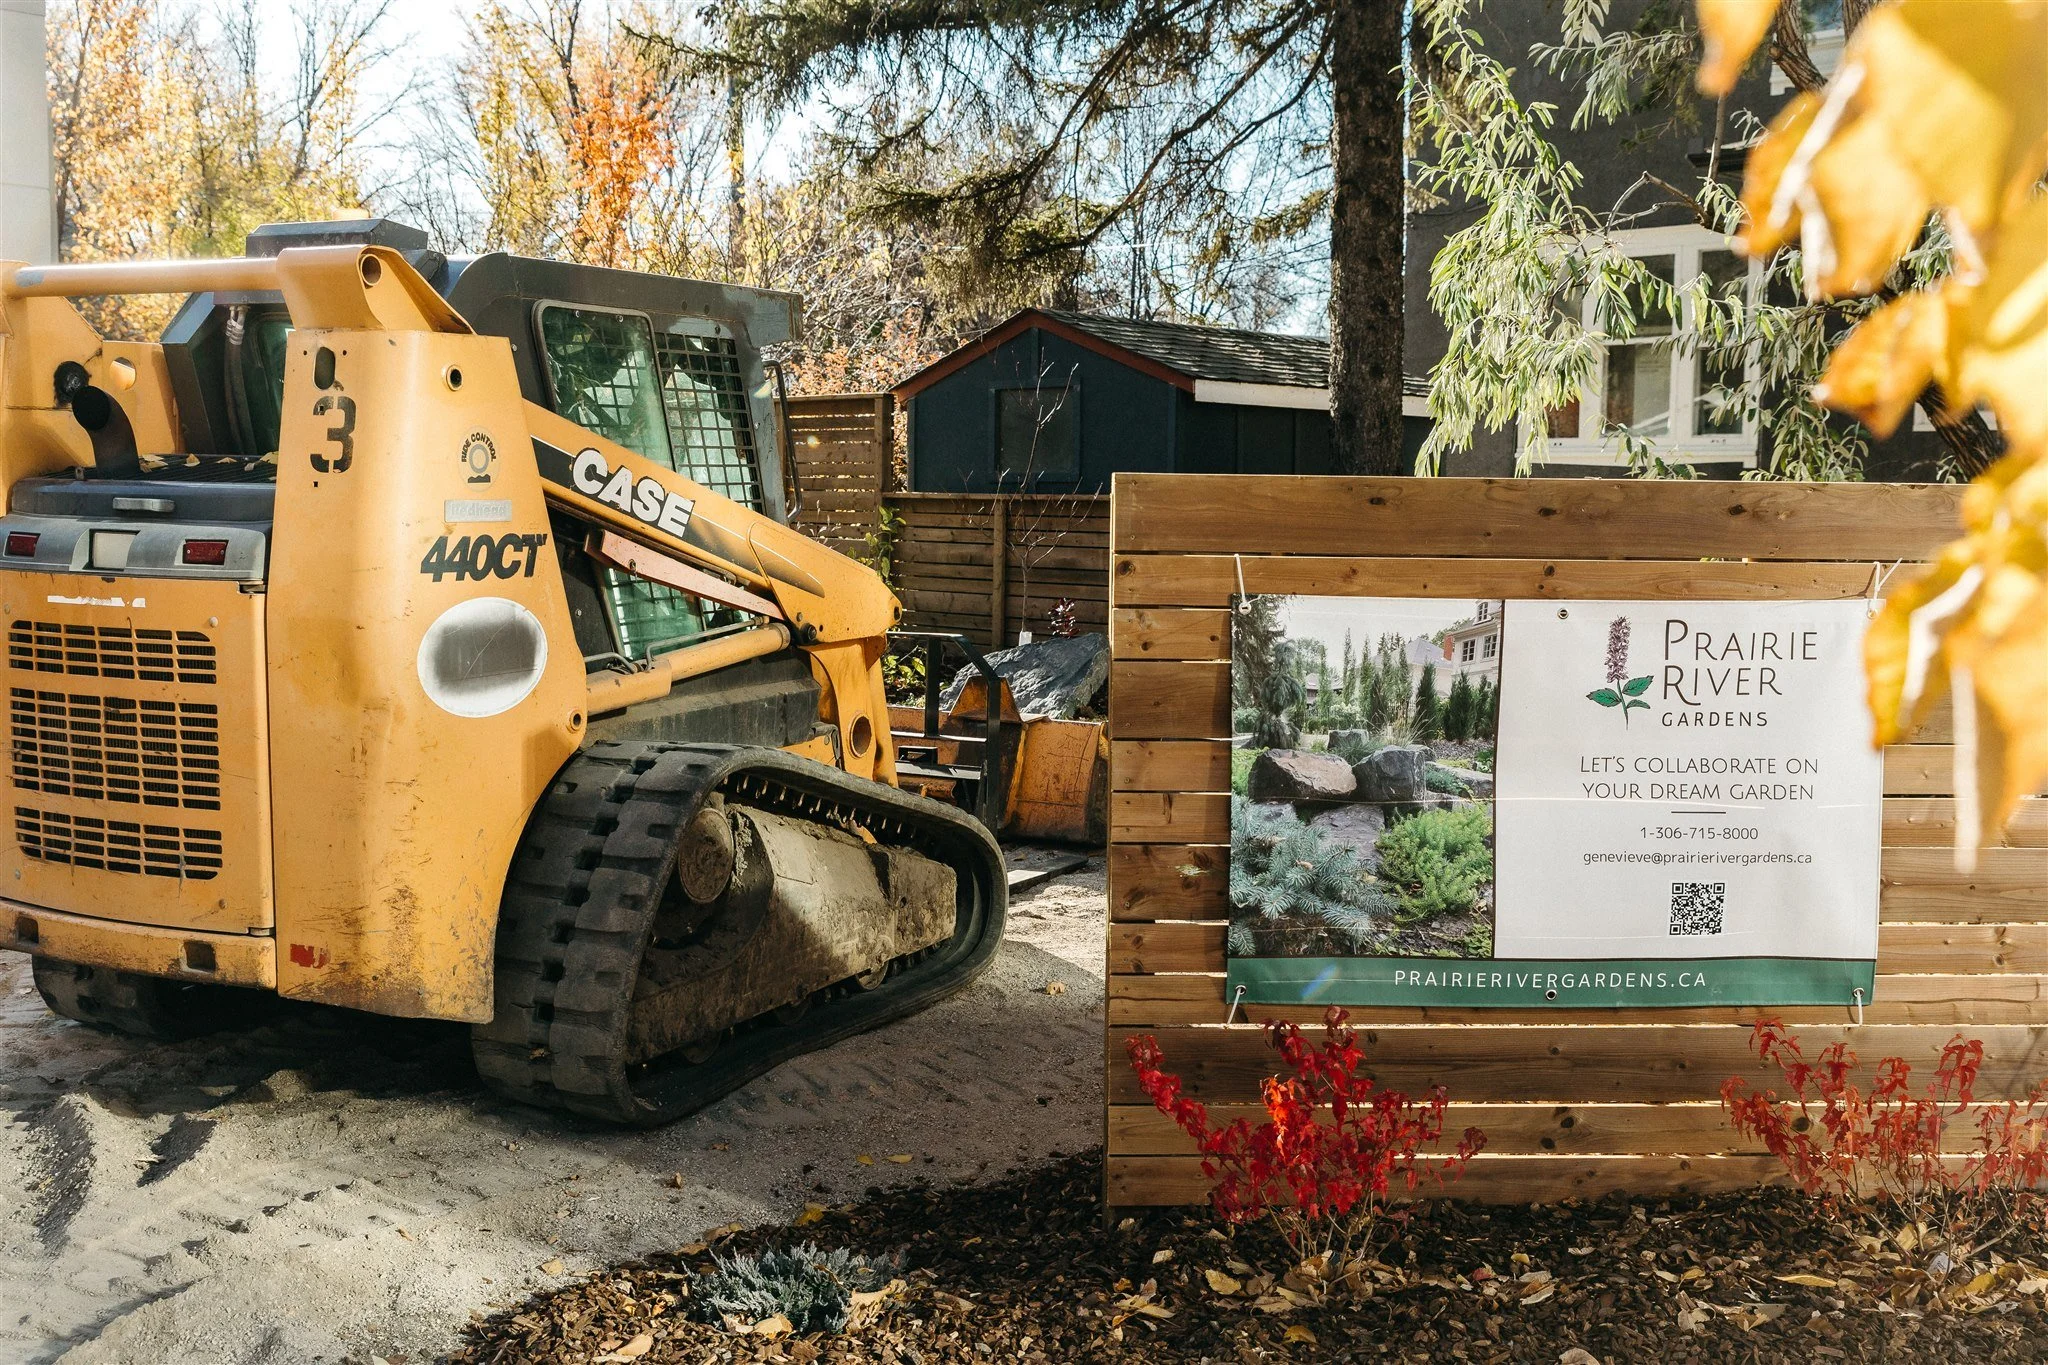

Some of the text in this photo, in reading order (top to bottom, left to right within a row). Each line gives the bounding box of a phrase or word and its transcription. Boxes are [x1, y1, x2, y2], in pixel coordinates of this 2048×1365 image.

[310, 395, 357, 474] 3
[461, 432, 497, 463] RIDE CONTROL
[572, 447, 696, 538] CASE
[1664, 619, 1818, 661] PRAIRIE
[1663, 664, 1783, 706] RIVER
[1661, 711, 1768, 727] GARDENS
[1580, 756, 1819, 774] LET'S COLLABORATE ON
[1582, 782, 1814, 801] YOUR DREAM GARDEN
[1639, 826, 1759, 841] 1-306-715-8000
[1583, 851, 1813, 867] genevieve@prairierivergardens.ca
[1394, 970, 1707, 988] PRAIRIERIVERGARDENS.CA
